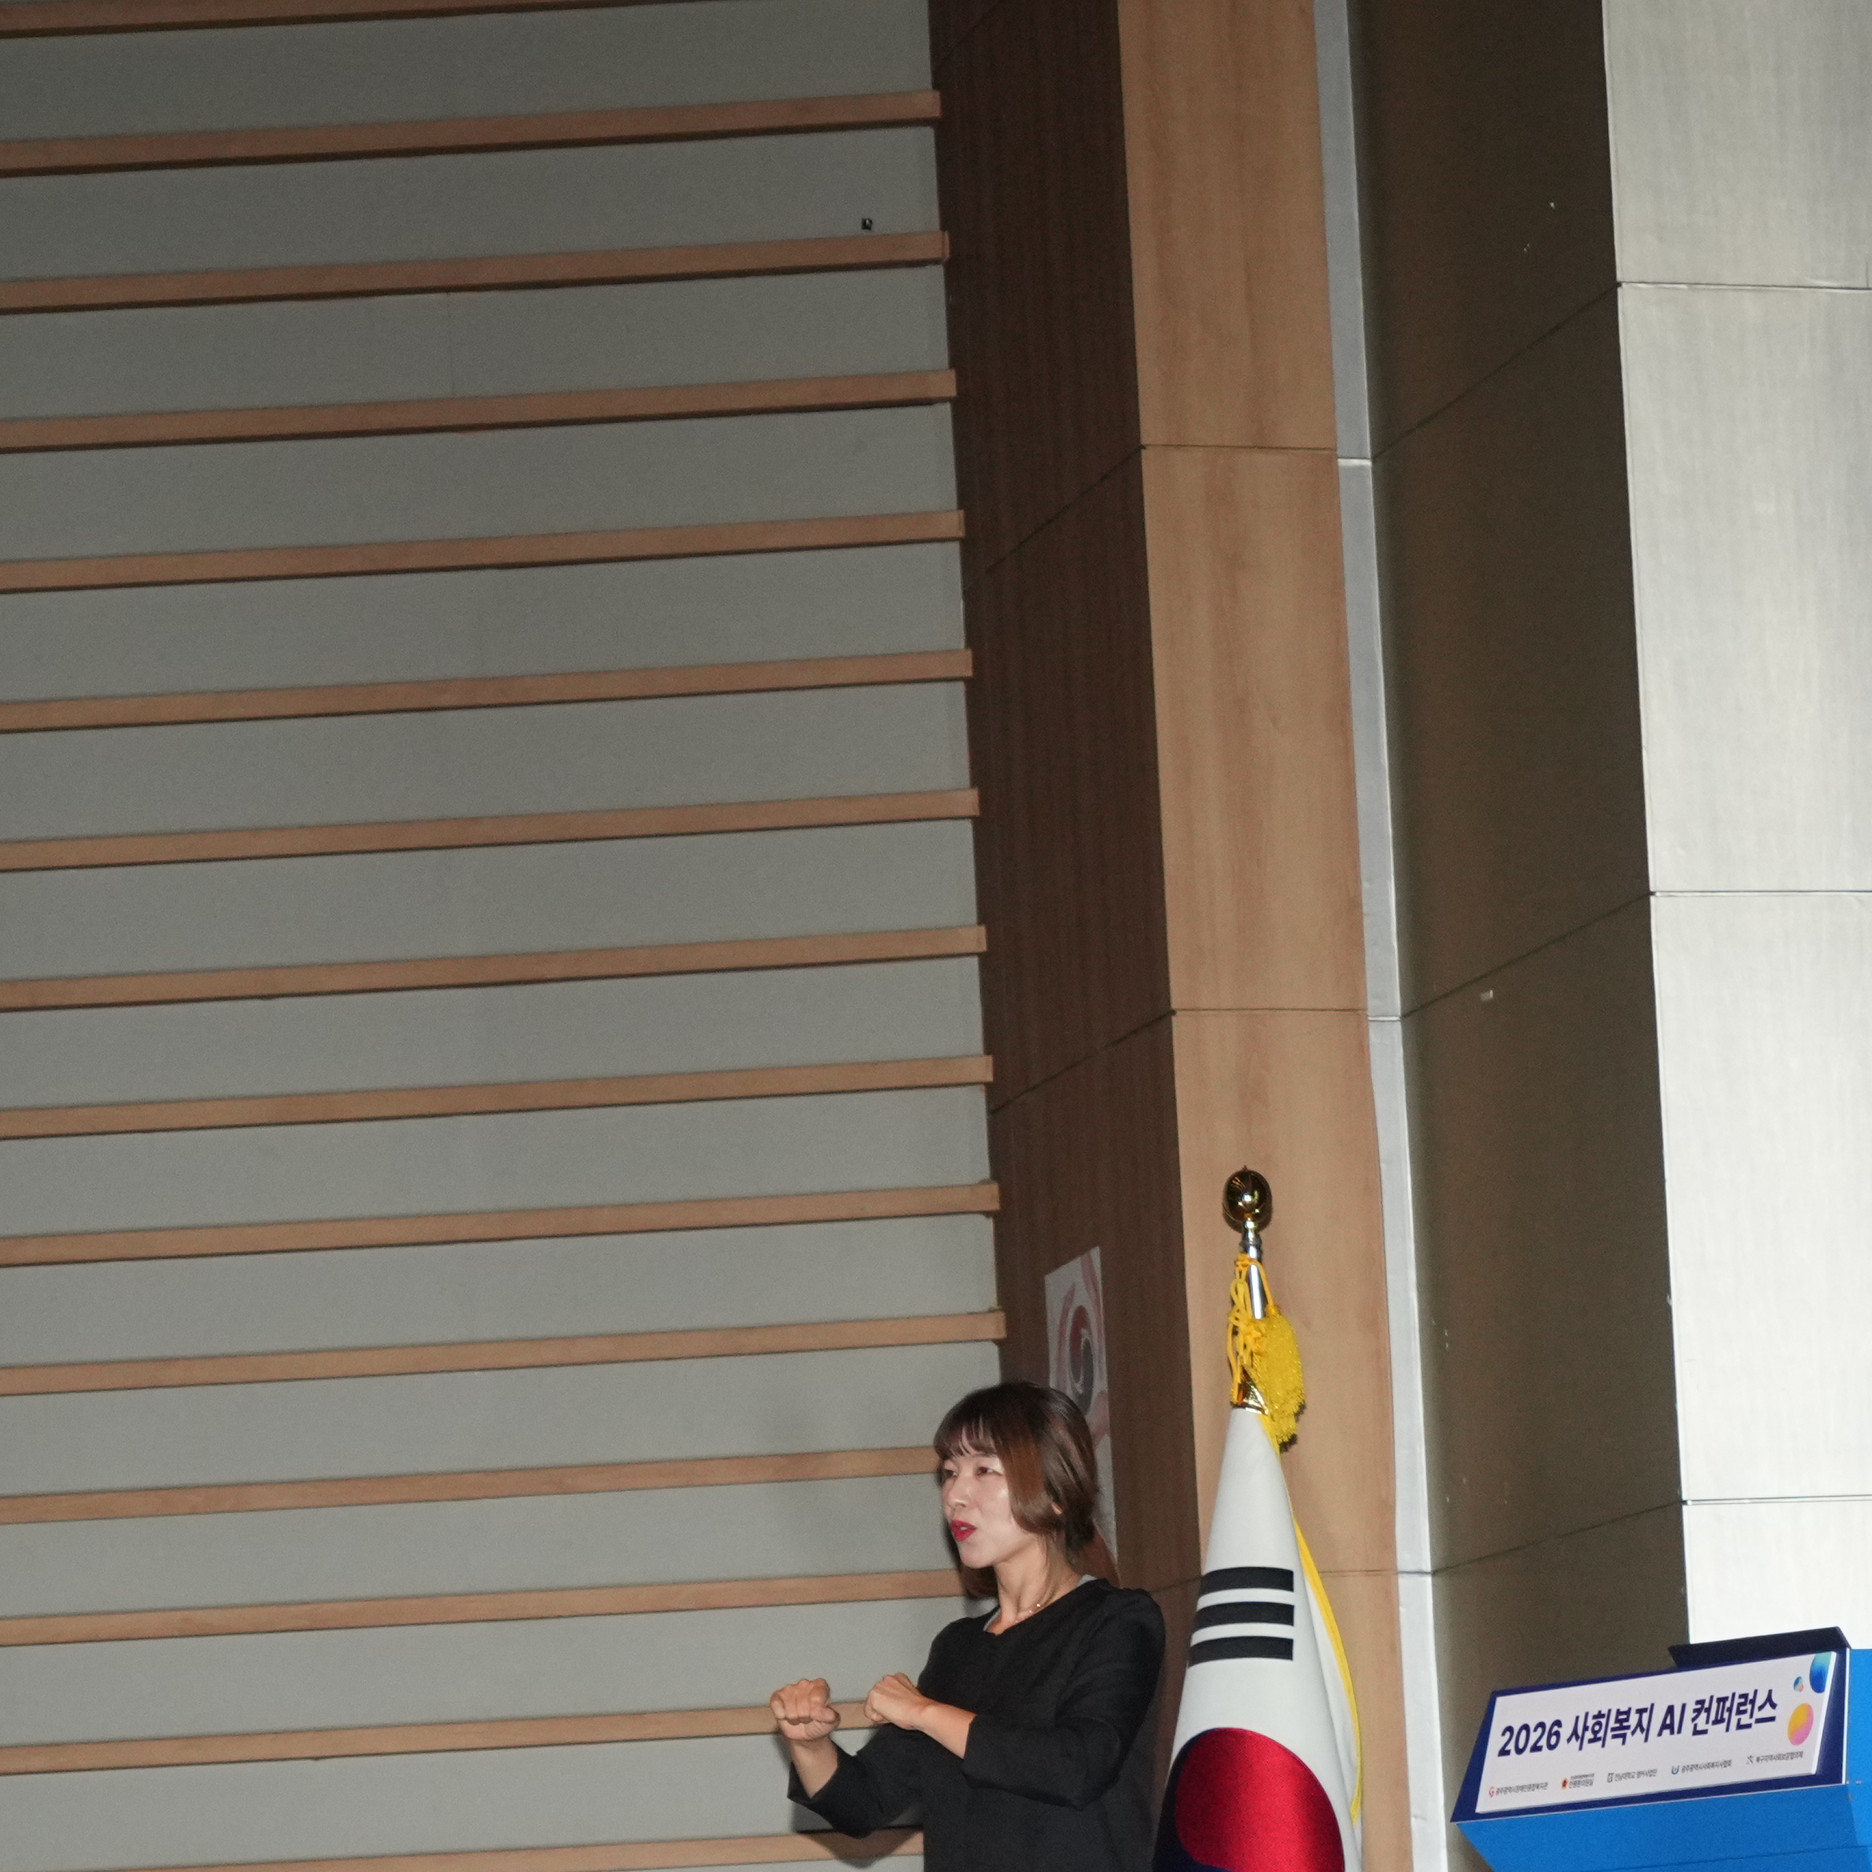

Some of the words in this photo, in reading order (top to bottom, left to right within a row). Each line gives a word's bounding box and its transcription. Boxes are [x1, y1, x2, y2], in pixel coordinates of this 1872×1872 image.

[1498, 1719, 1562, 1757] 2026
[1566, 1703, 1655, 1751] 사회복지
[1657, 1703, 1687, 1738] AI
[1691, 1689, 1778, 1736] 컨퍼런스
